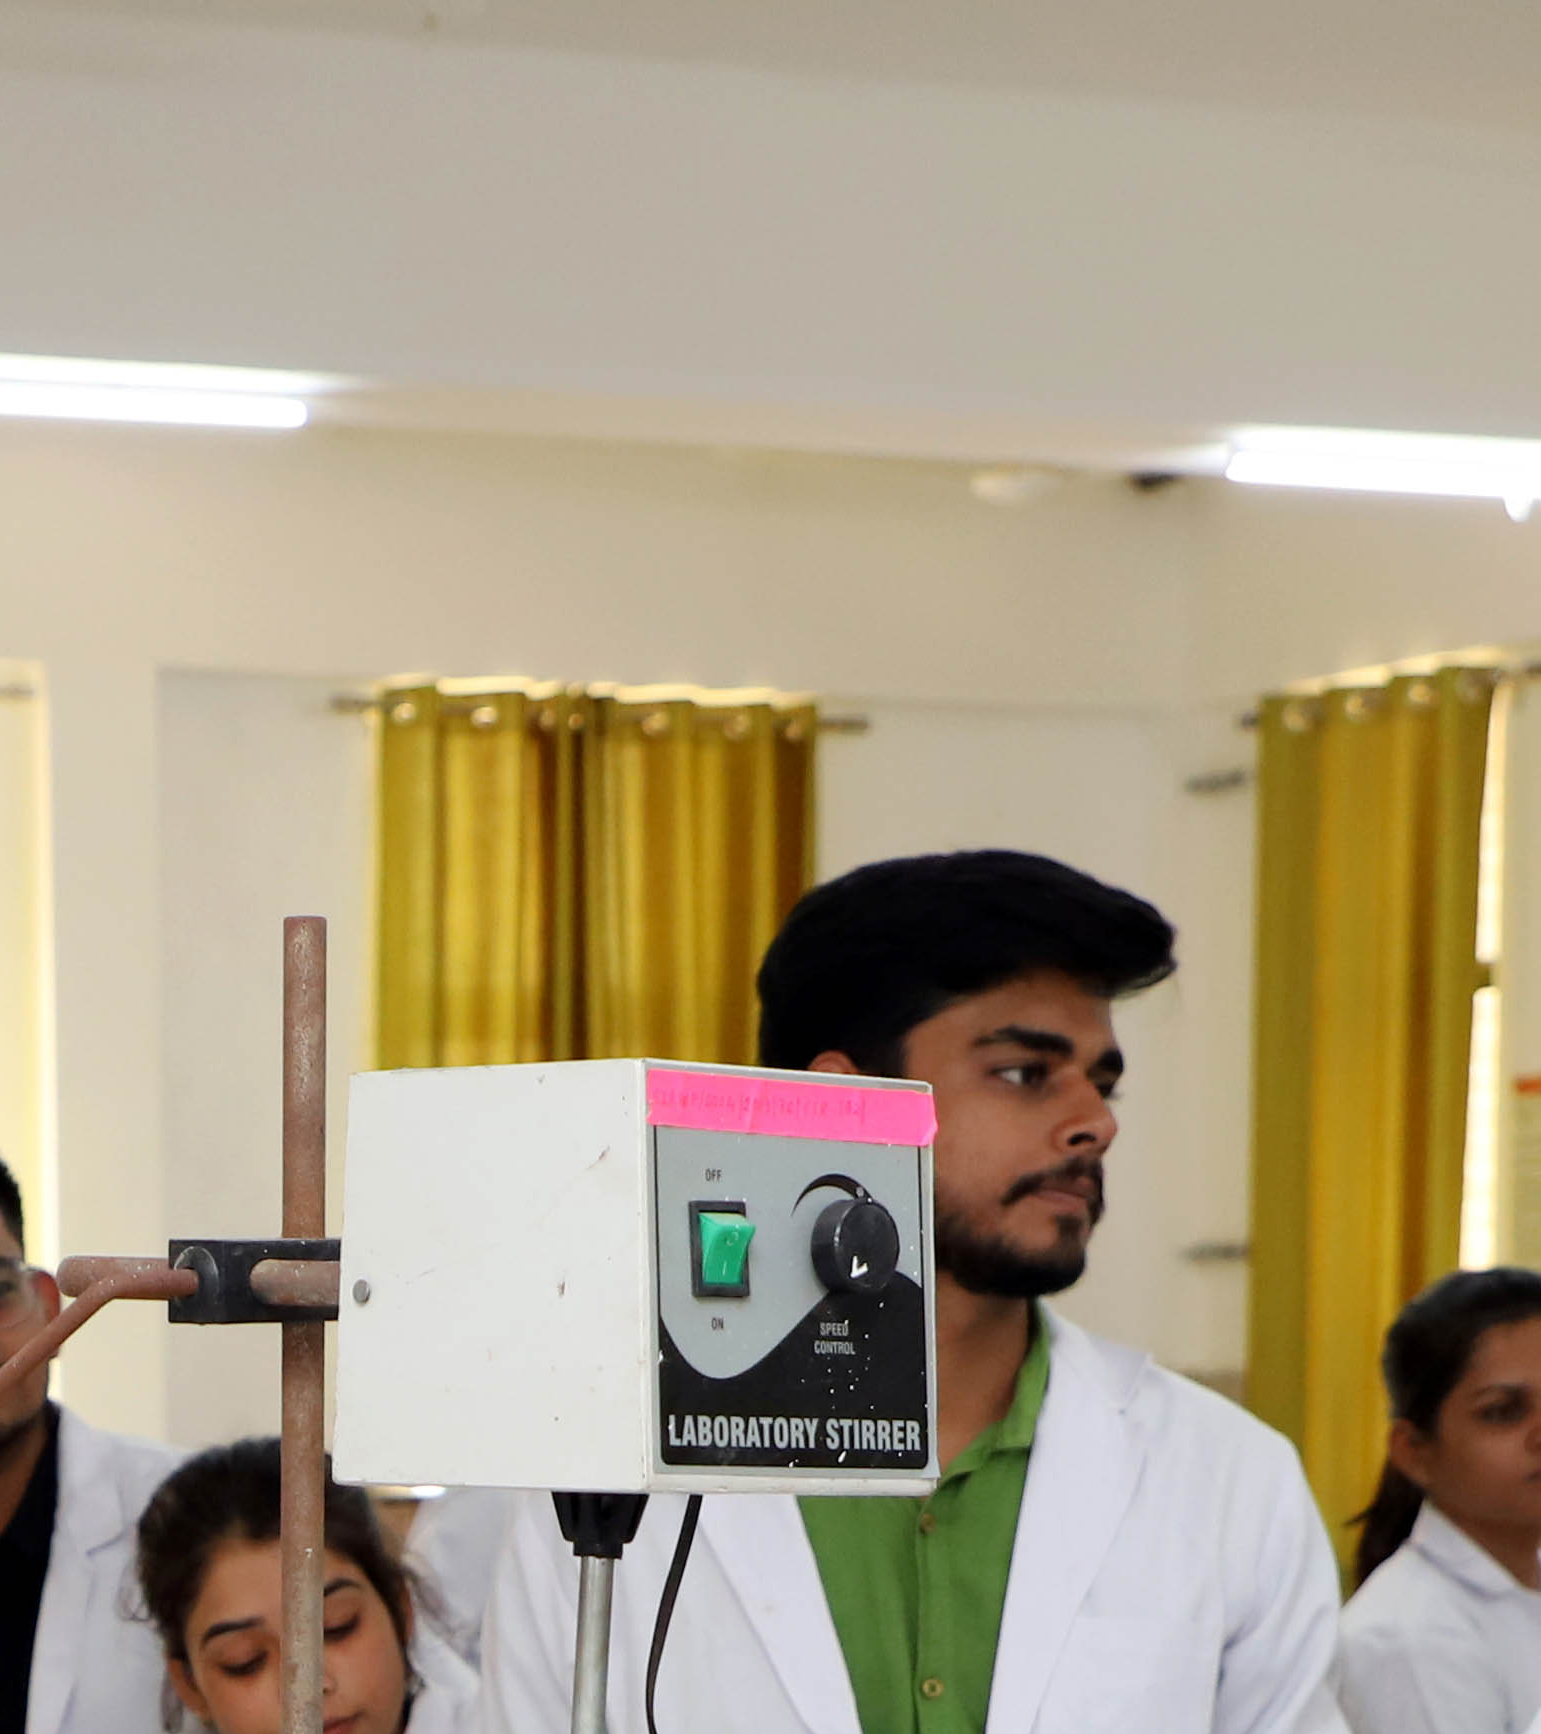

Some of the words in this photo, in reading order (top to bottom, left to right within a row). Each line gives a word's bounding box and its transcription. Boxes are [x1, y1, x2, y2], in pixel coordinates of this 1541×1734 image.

[705, 1168, 723, 1182] OFF
[711, 1317, 724, 1331] ON
[820, 1321, 849, 1337] SPEED
[814, 1340, 856, 1355] CONTROL
[668, 1414, 820, 1449] LABORATORY
[825, 1419, 921, 1452] STIRRER
